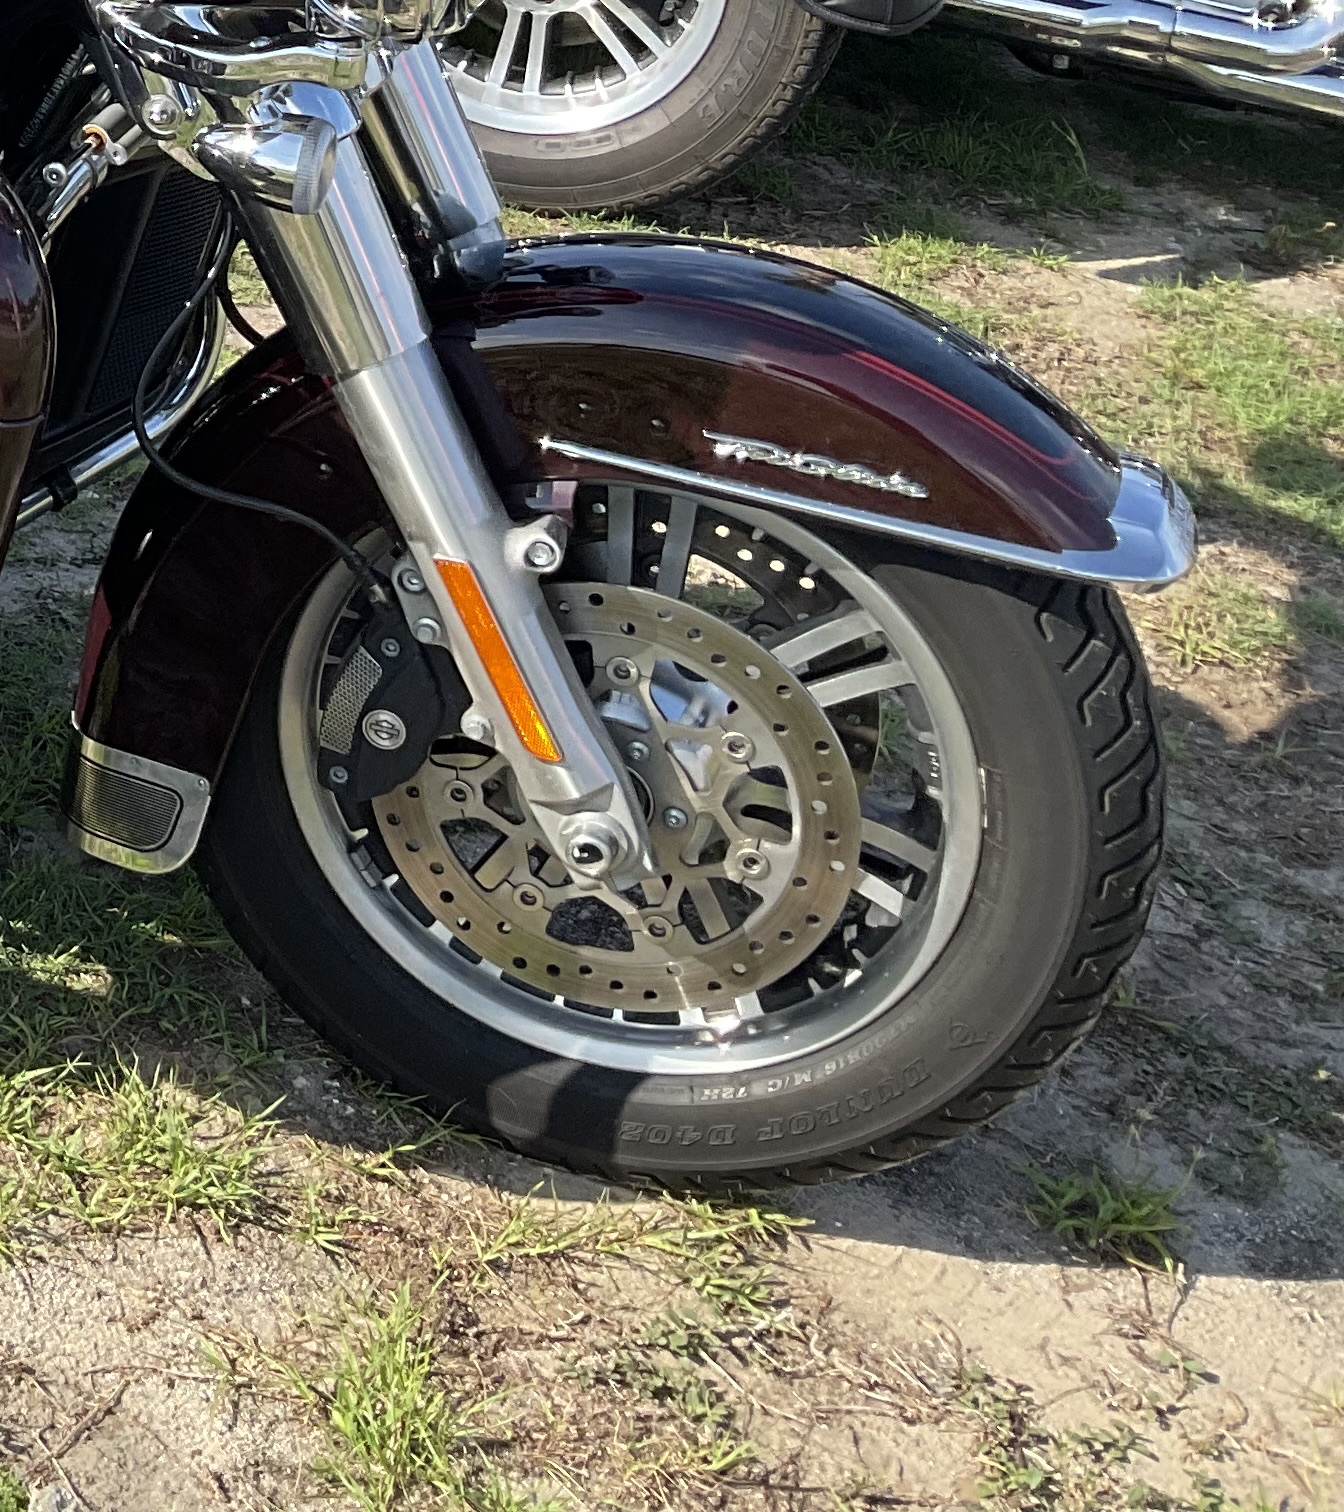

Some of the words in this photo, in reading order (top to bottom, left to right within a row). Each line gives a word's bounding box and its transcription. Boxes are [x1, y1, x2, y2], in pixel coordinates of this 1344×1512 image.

[701, 1086, 749, 1101] 72H
[767, 1068, 813, 1093] M/C
[756, 1058, 933, 1143] DUNLOP
[618, 1120, 737, 1147] D402
